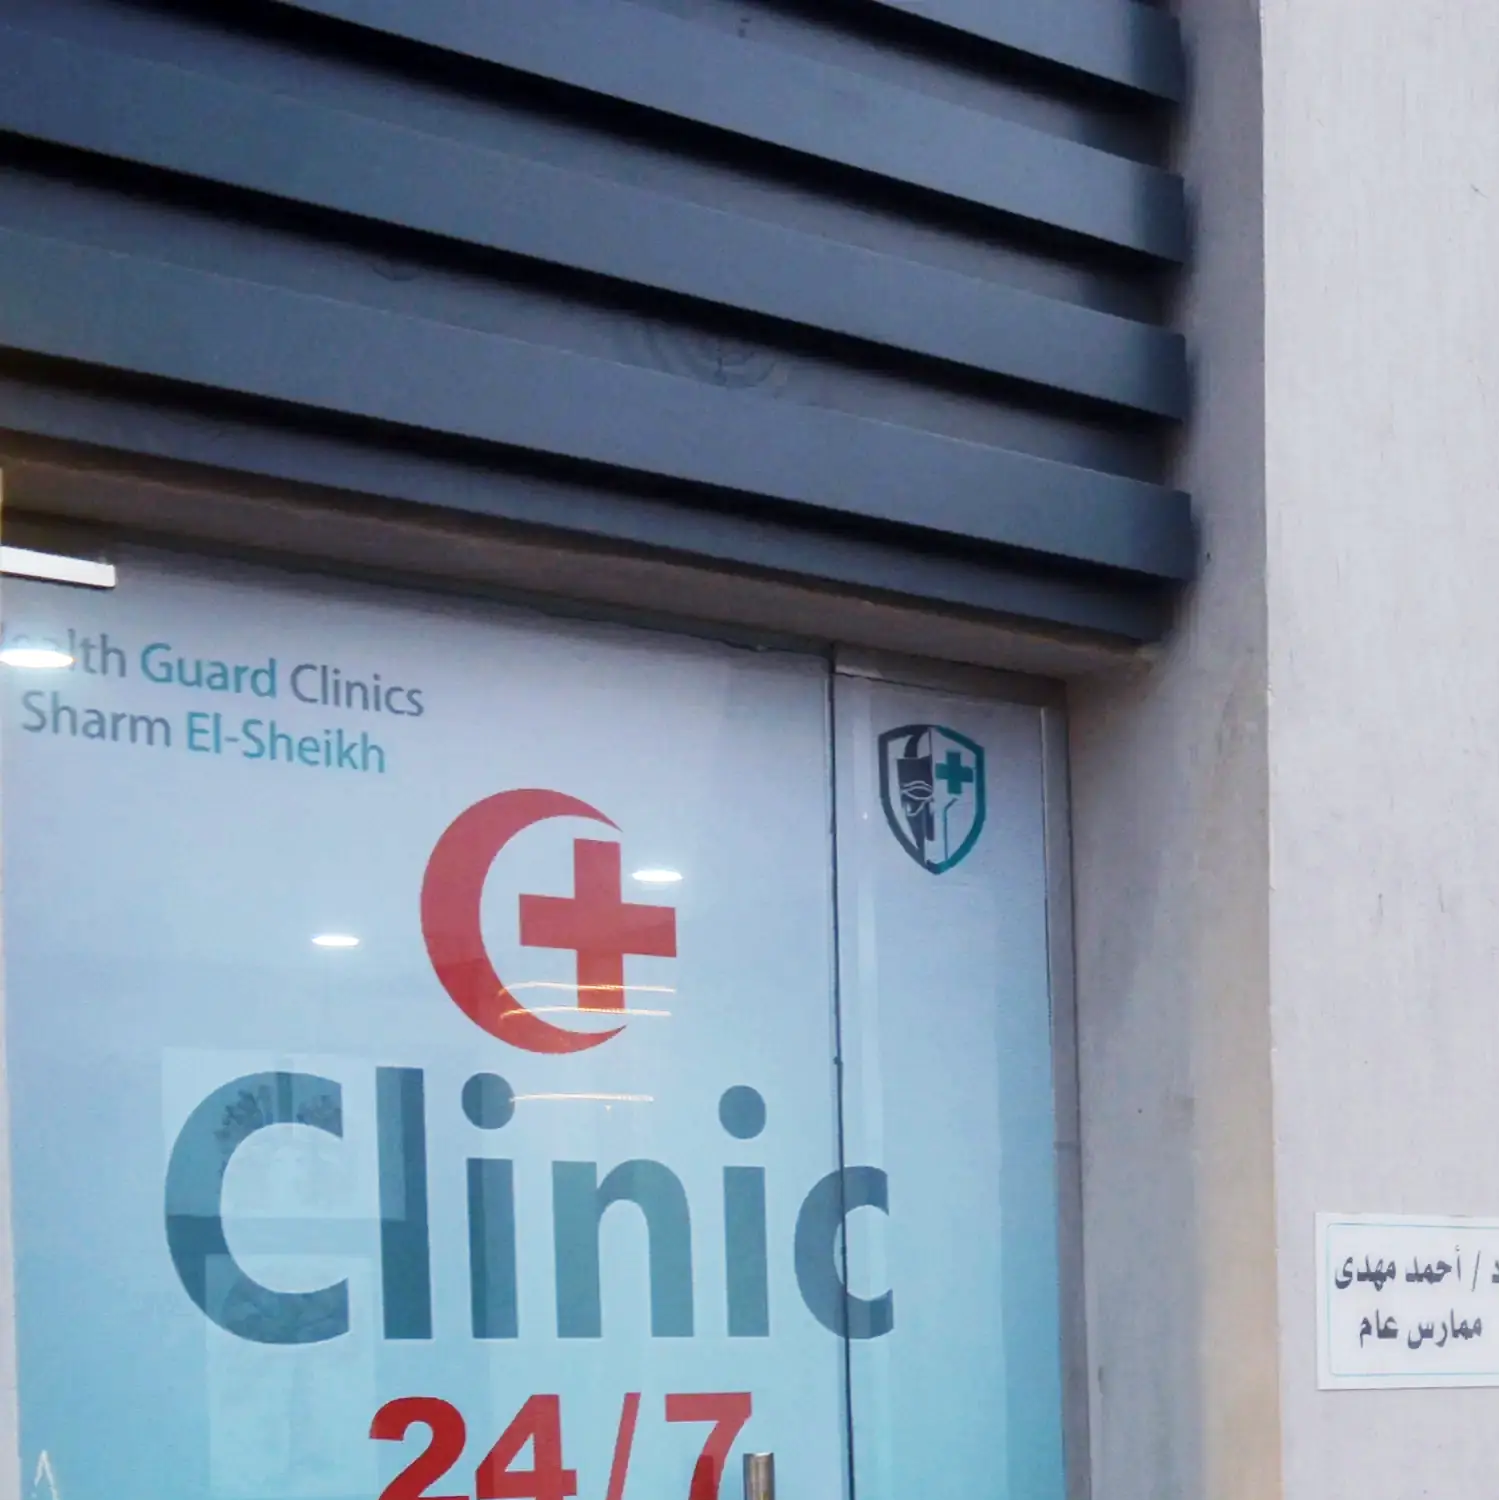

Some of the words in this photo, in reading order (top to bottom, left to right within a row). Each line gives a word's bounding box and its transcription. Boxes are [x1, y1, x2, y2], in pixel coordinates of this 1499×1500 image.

[140, 642, 277, 698] Guard
[290, 664, 425, 717] Clinics
[21, 690, 171, 748] Sharm
[187, 712, 385, 774] El-Sheikh
[163, 1066, 895, 1345] Clinic
[1405, 1243, 1462, 1285] أحمد
[1359, 1307, 1398, 1349] عام
[1407, 1307, 1483, 1350] ممارس
